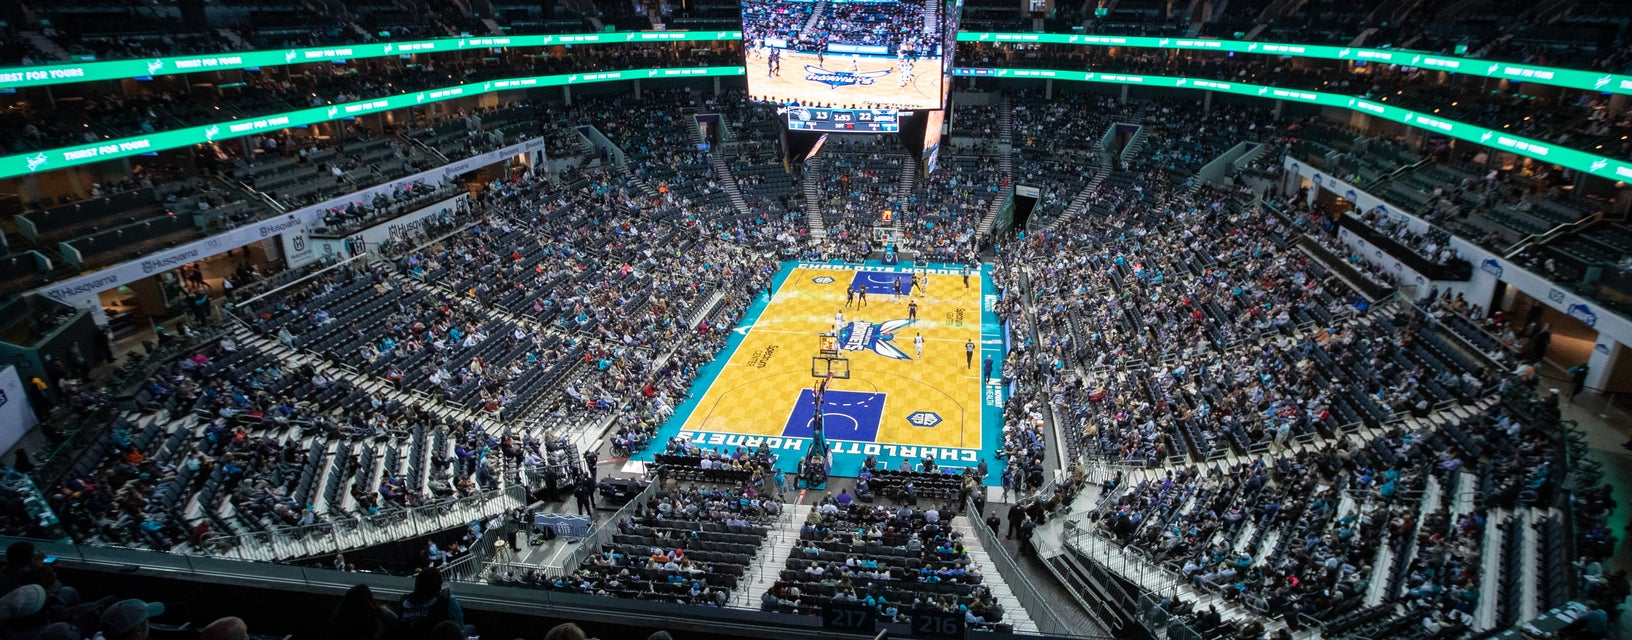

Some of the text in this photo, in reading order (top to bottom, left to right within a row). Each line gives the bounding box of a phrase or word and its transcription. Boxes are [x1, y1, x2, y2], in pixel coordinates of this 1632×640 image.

[175, 60, 201, 68] THIRST
[26, 70, 48, 80] FOR
[49, 68, 84, 78] YOURS
[816, 111, 828, 119] 13
[859, 112, 872, 120] 22
[229, 117, 289, 132] THIRST FOR YOURS
[63, 140, 150, 159] THIRST FOR YOURS
[267, 219, 301, 236] Husqvarna
[153, 249, 198, 268] Husqvarna
[798, 263, 896, 273] CHARLOTTE
[61, 274, 118, 297] Husqvarna
[831, 609, 867, 628] 217
[919, 615, 957, 635] 216
